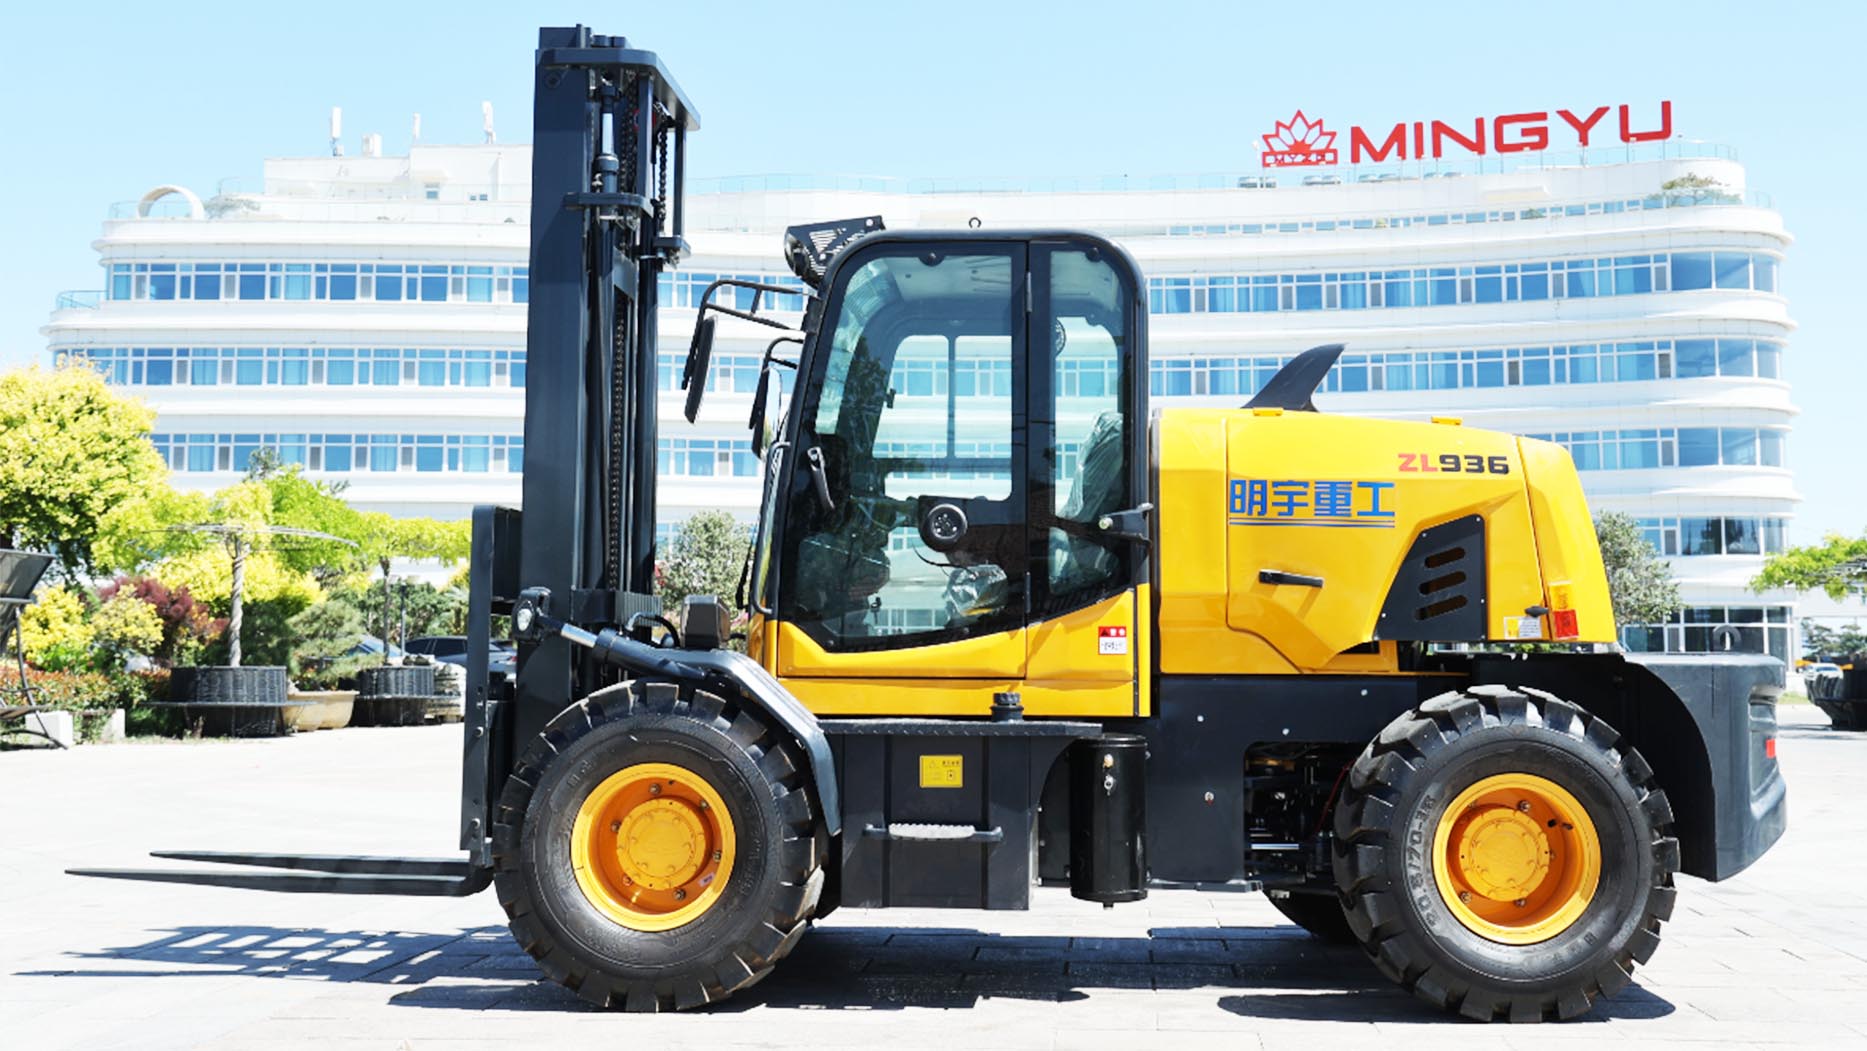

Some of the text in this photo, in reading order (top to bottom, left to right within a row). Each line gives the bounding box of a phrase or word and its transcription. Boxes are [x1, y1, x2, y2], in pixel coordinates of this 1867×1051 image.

[1350, 100, 1672, 163] MINGYU
[1398, 453, 1510, 475] ZL936
[1229, 479, 1396, 517] 明宇重工
